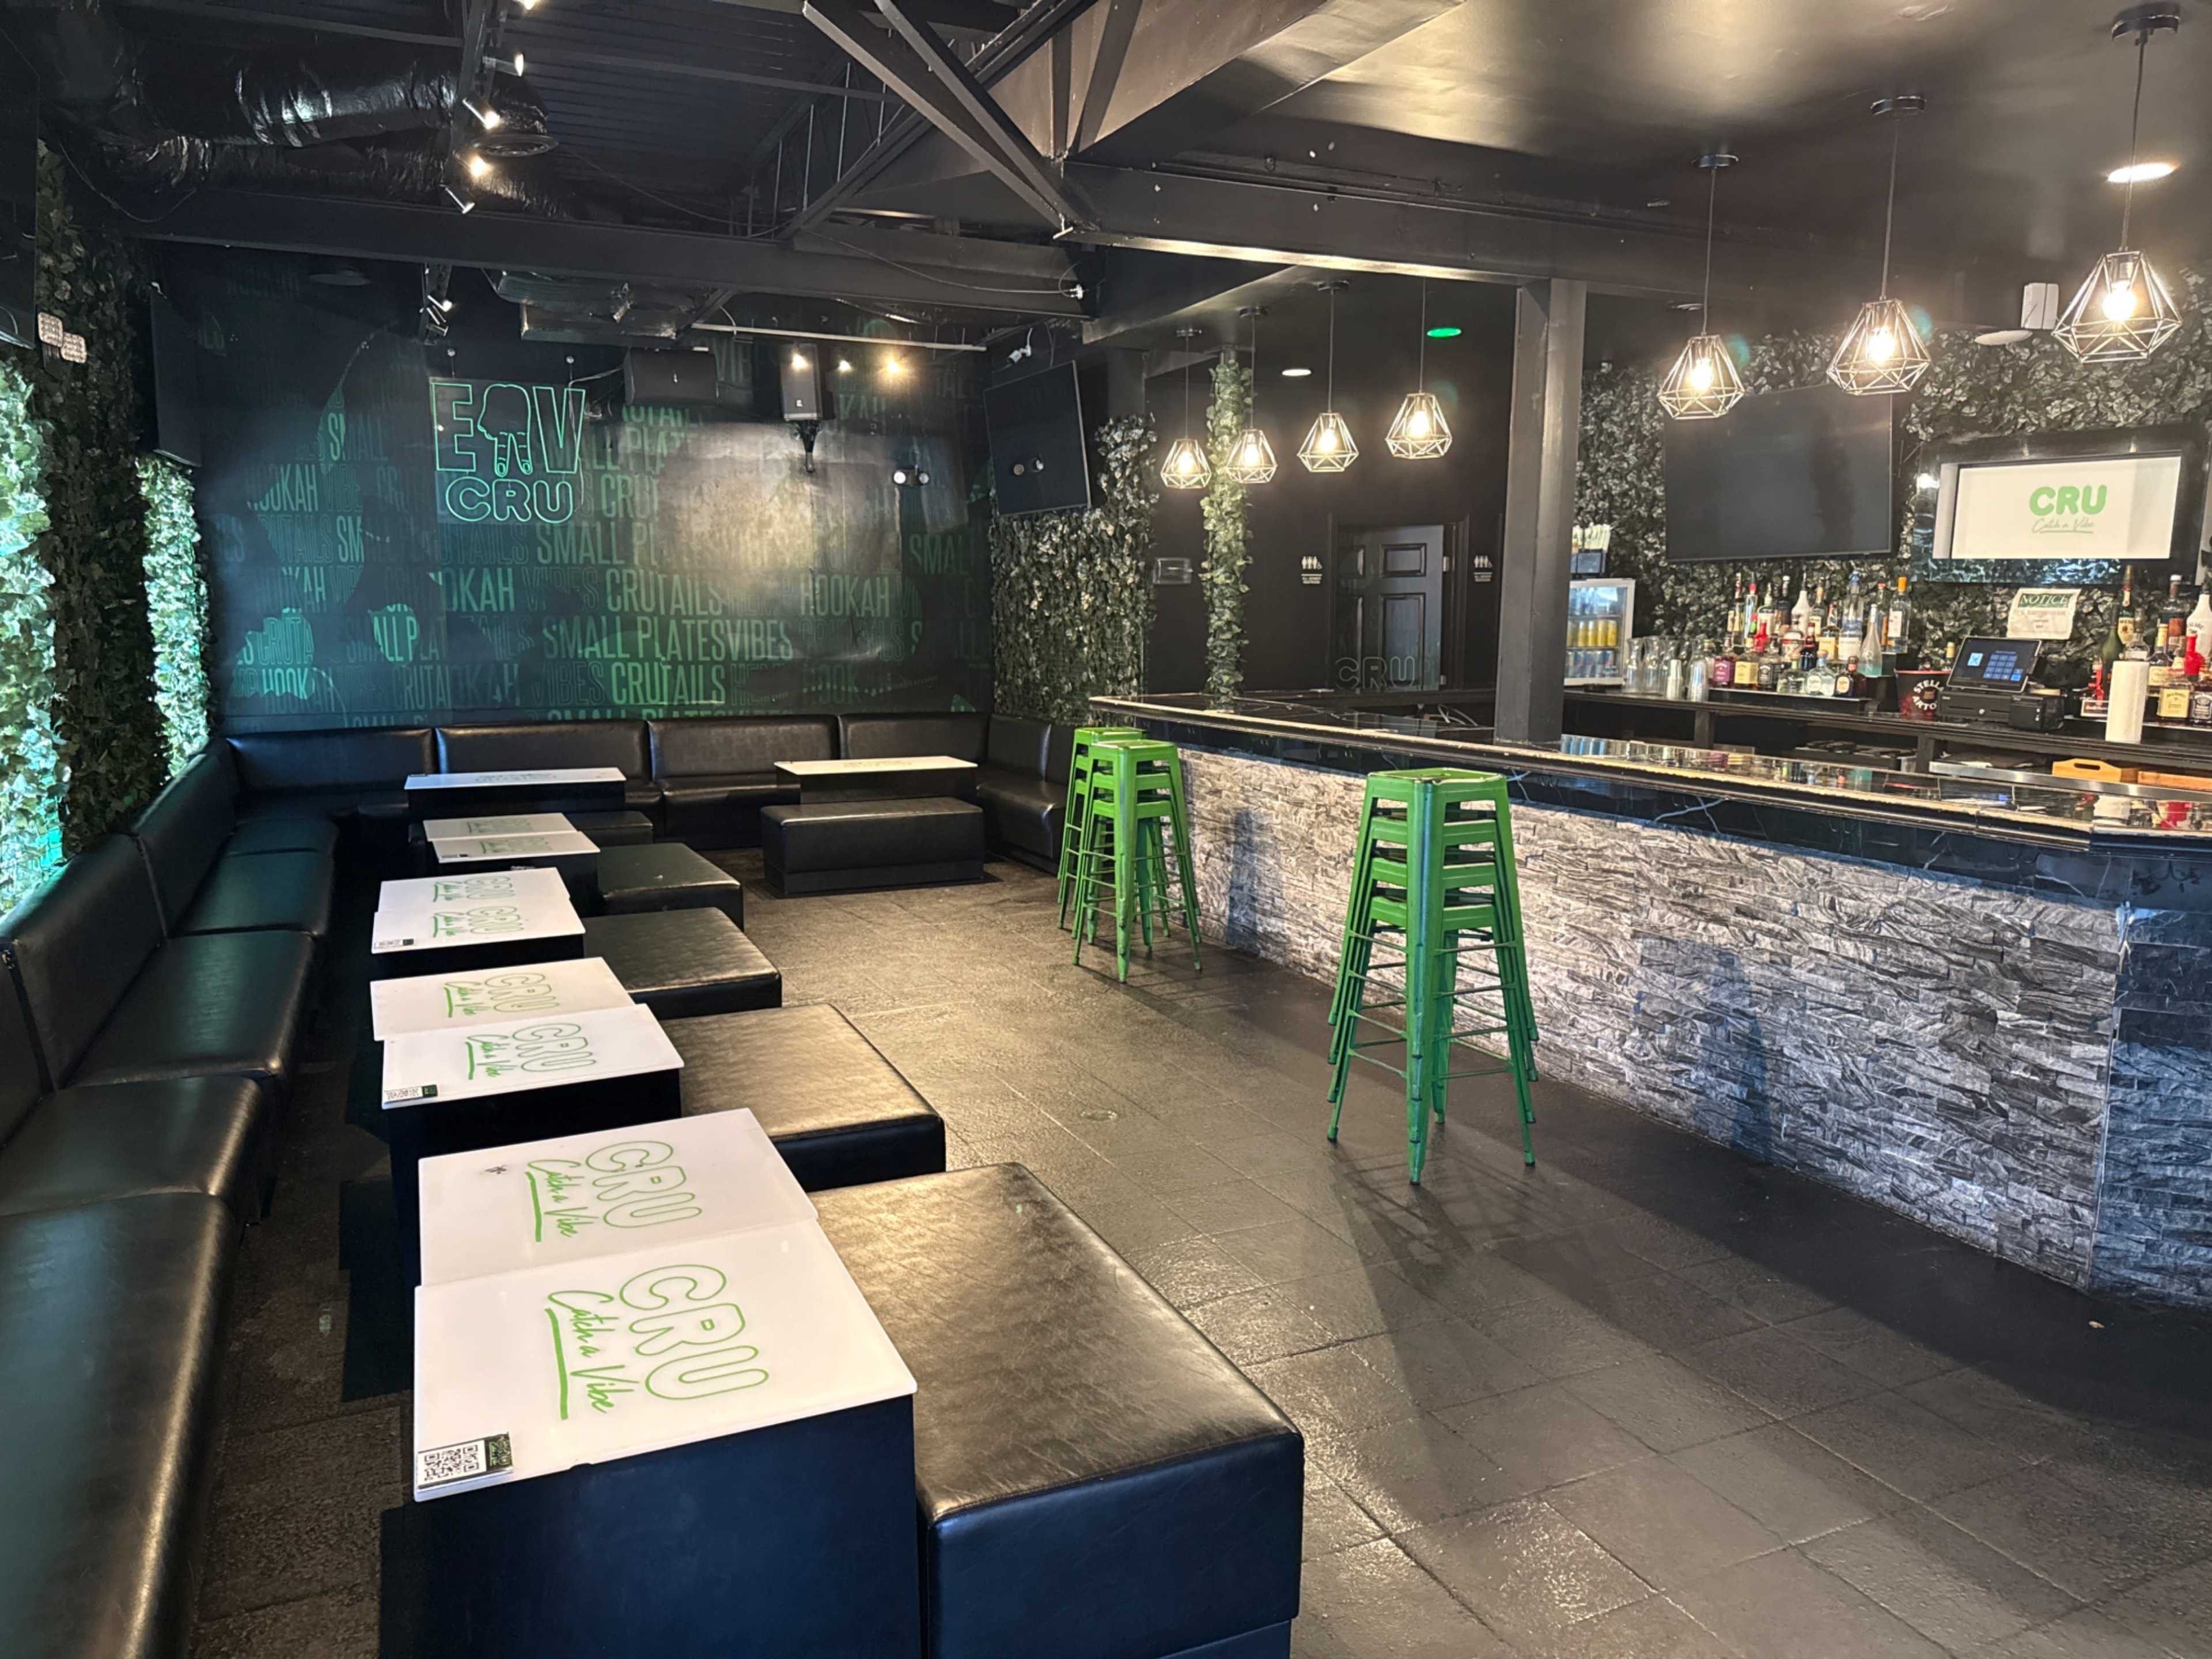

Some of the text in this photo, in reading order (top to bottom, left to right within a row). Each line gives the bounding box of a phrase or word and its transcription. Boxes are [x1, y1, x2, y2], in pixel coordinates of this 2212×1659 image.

[446, 476, 574, 524] CRU
[2029, 484, 2108, 516] CRU
[536, 521, 626, 566] SMALL
[606, 568, 723, 616] CRUTAILS
[800, 574, 891, 618] HOOKAH
[2020, 593, 2069, 605] NOTICE
[542, 615, 630, 660] SMALL
[636, 616, 726, 662] PLATES
[611, 661, 726, 706] CRUTAILS
[1334, 656, 1415, 691] CRU
[1912, 695, 1938, 710] ARTO
[484, 972, 560, 1013] CRU
[512, 1022, 597, 1073] CRU
[527, 1159, 585, 1194] Catch
[585, 1141, 703, 1228] CRU
[543, 1206, 600, 1237] Vibe
[547, 1290, 620, 1344] Catch
[619, 1264, 770, 1401] CRU
[570, 1364, 641, 1414] Vibe
